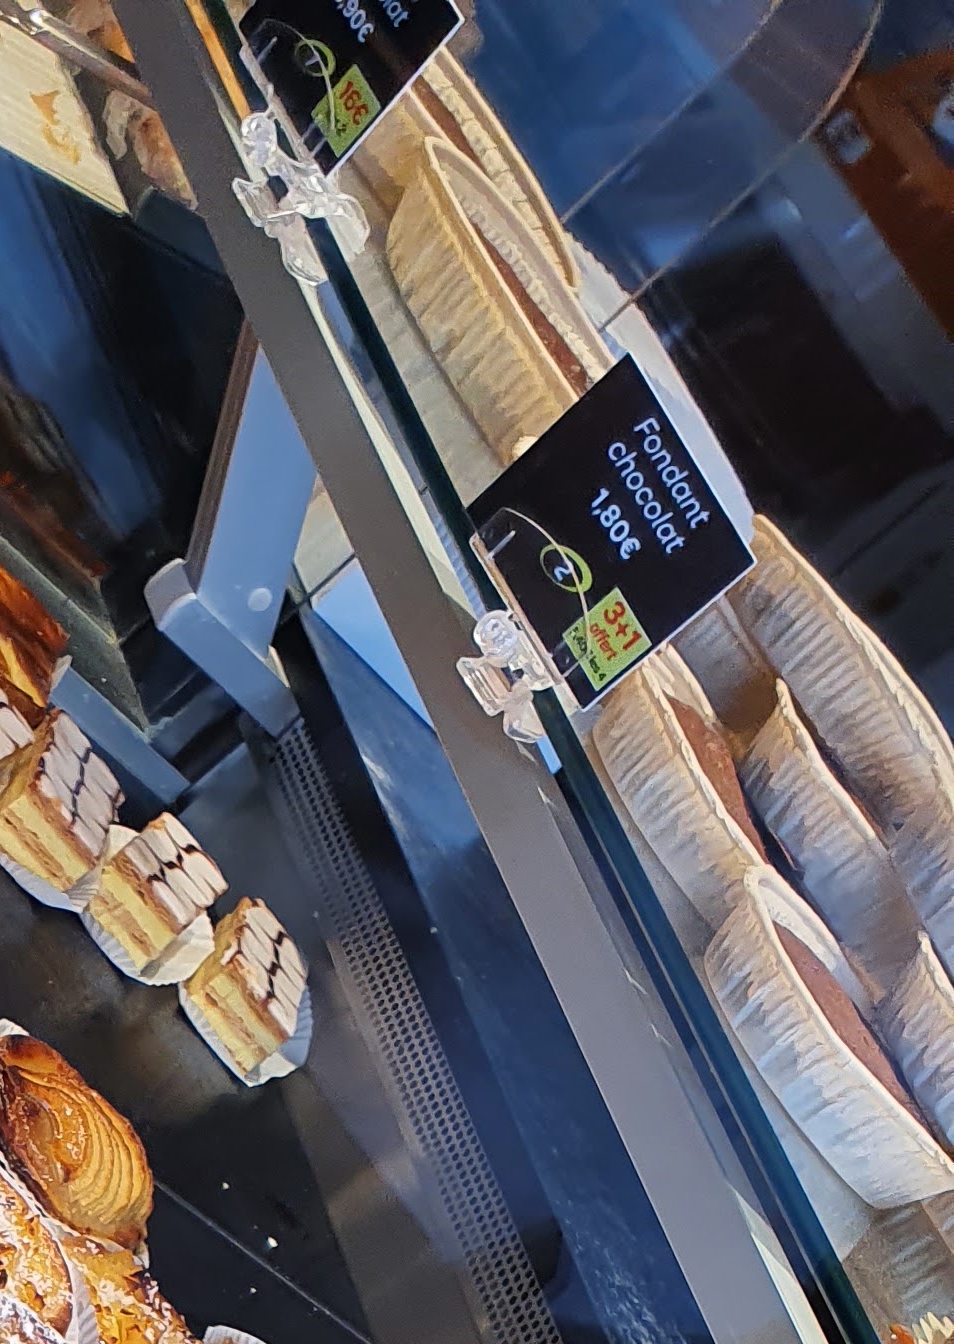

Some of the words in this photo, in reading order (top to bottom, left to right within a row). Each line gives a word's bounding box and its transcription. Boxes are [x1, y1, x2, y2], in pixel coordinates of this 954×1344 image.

[608, 441, 686, 554] chocolat
[634, 417, 710, 530] Fondant
[590, 487, 642, 561] 1,80€
[590, 623, 617, 661] offert
[604, 601, 642, 651] 3+1
